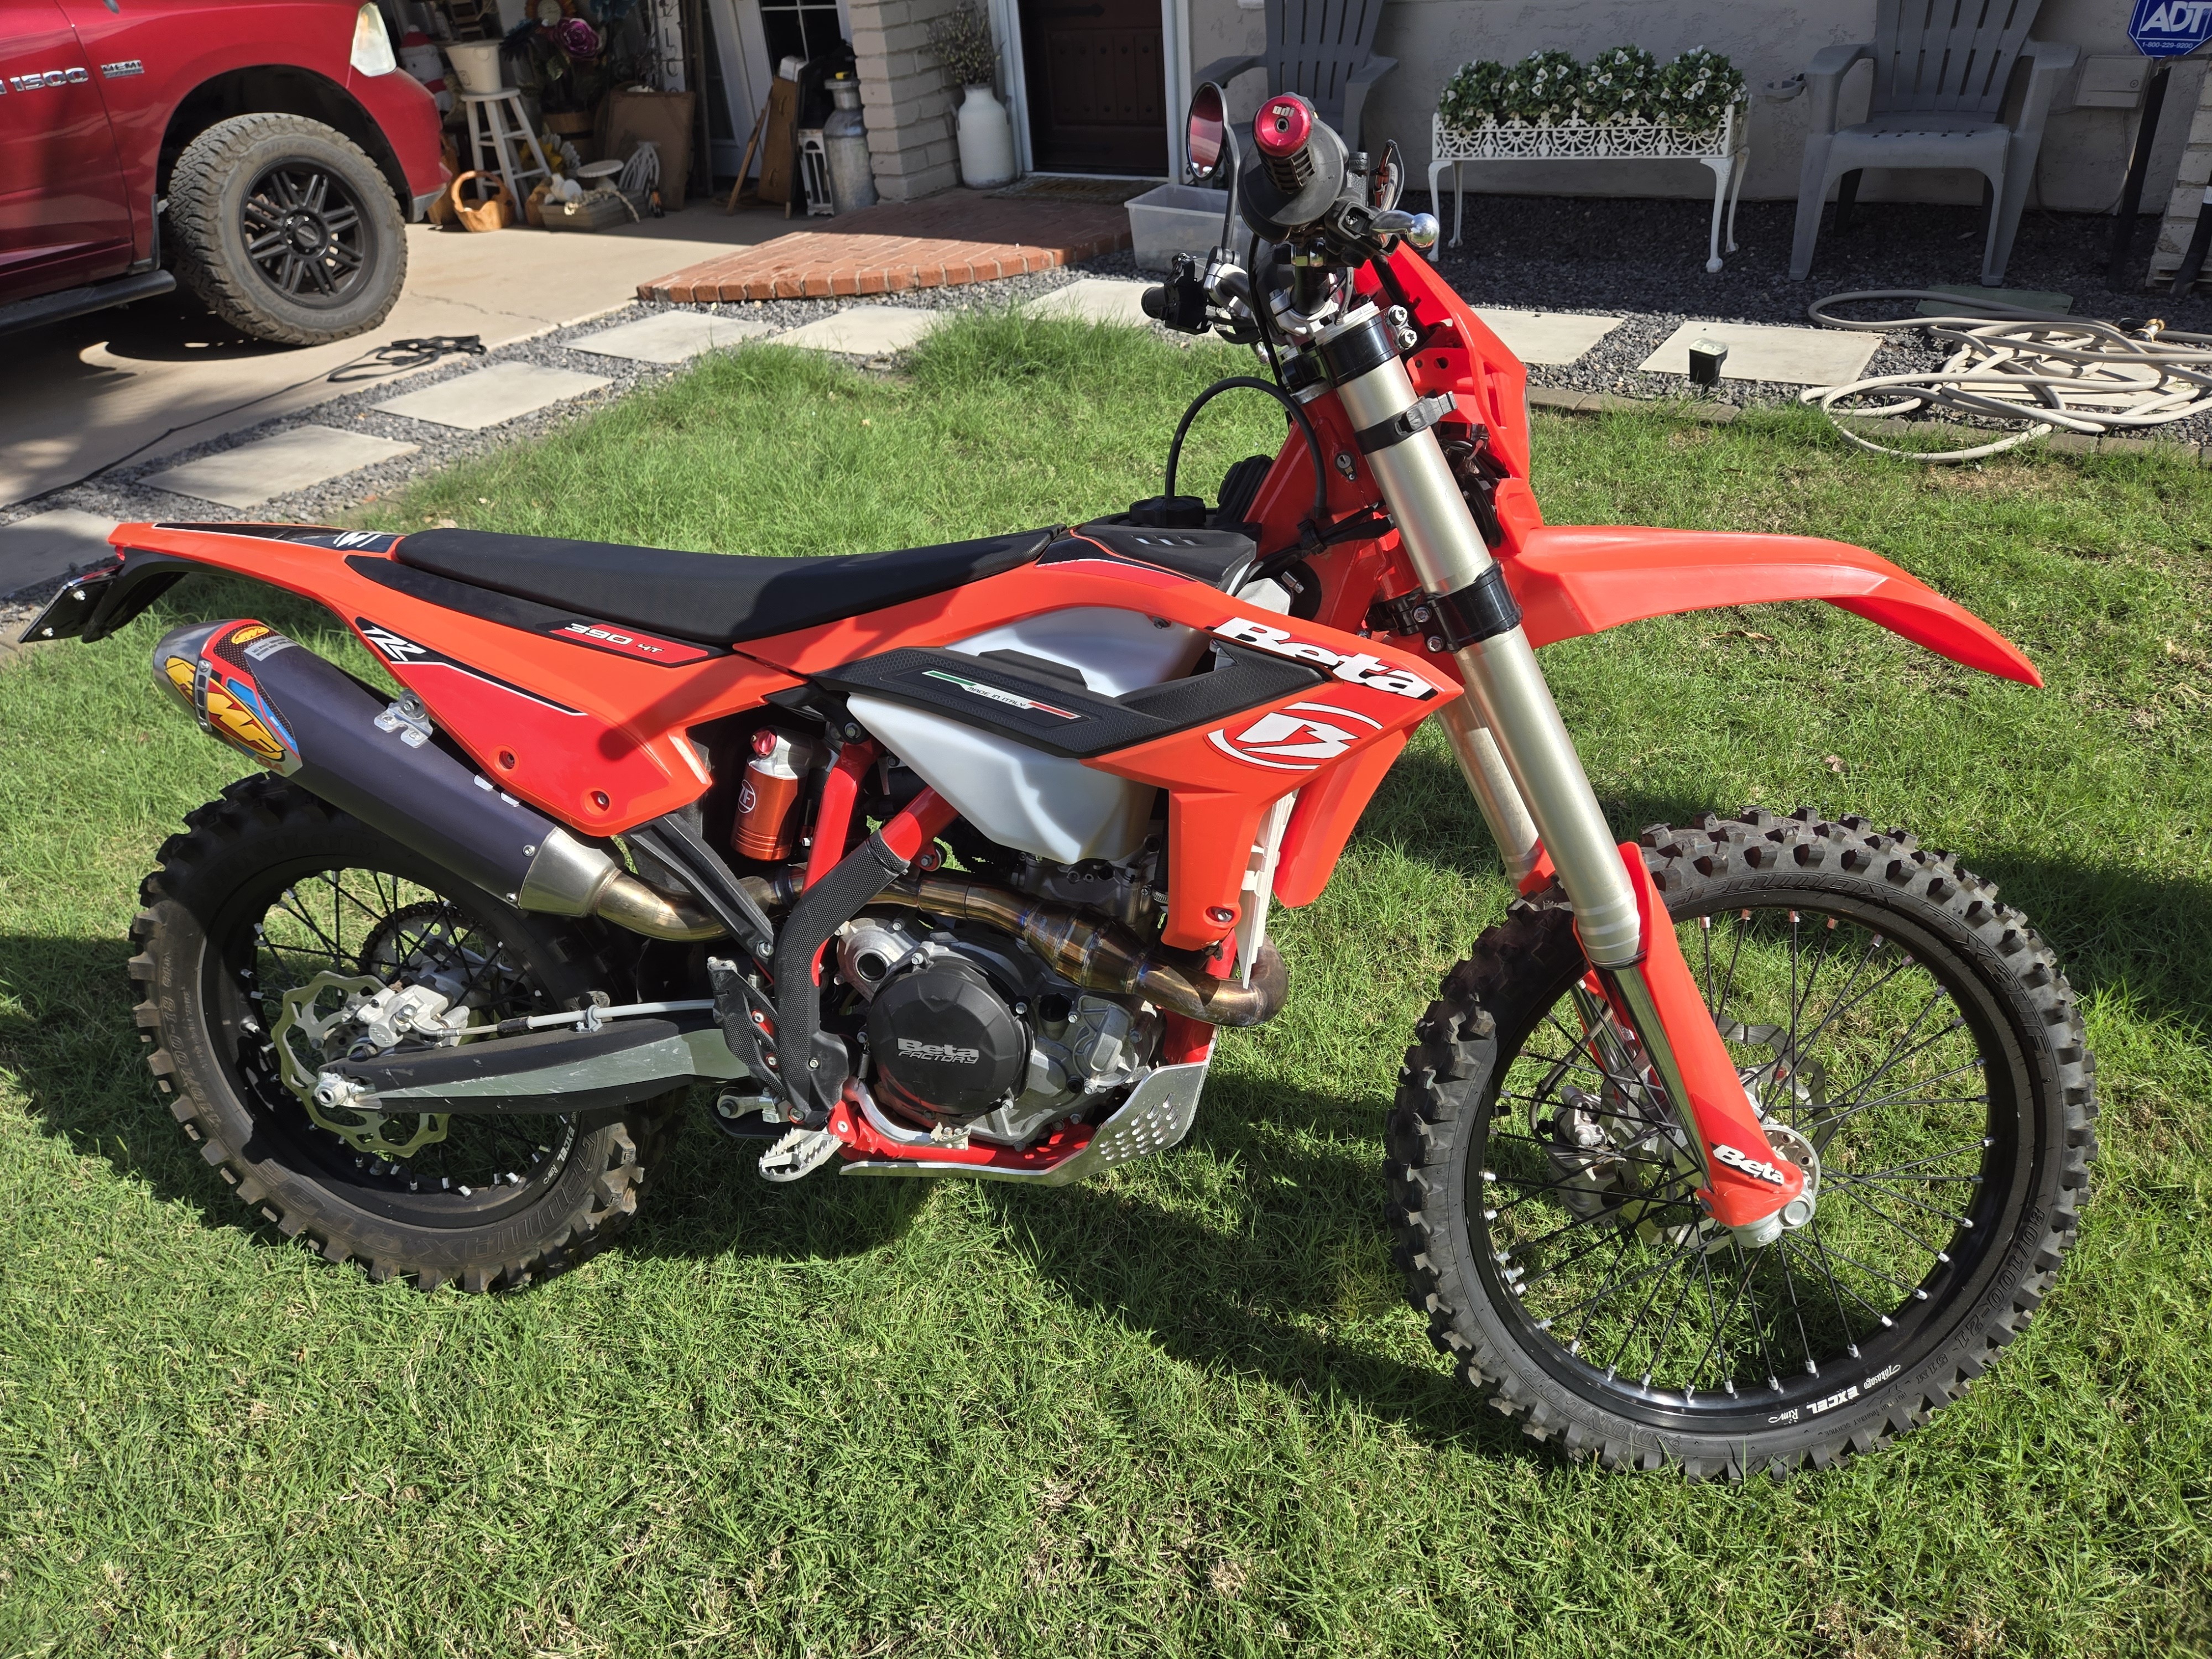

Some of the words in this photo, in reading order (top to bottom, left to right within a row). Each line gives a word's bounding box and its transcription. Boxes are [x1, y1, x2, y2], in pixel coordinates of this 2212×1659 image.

[2140, 1, 2212, 33] ADT
[9, 67, 89, 92] 1500
[1272, 106, 1295, 117] odi
[564, 623, 634, 645] 390
[636, 643, 665, 654] 4T
[1212, 616, 1433, 699] Beta
[967, 686, 991, 696] MADE
[1001, 697, 1027, 707] ITALY
[161, 996, 221, 1125] 110/100-18
[898, 1038, 979, 1057] Beta
[898, 1051, 979, 1064] FACTORY
[557, 1125, 575, 1162] EXCEL
[1713, 1144, 1785, 1185] Beta
[1955, 1205, 2046, 1349] 80/100-21
[1864, 1364, 1901, 1390] Takasago
[1519, 1368, 1663, 1449] DUNLOP
[1806, 1385, 1860, 1414] EXCEL
